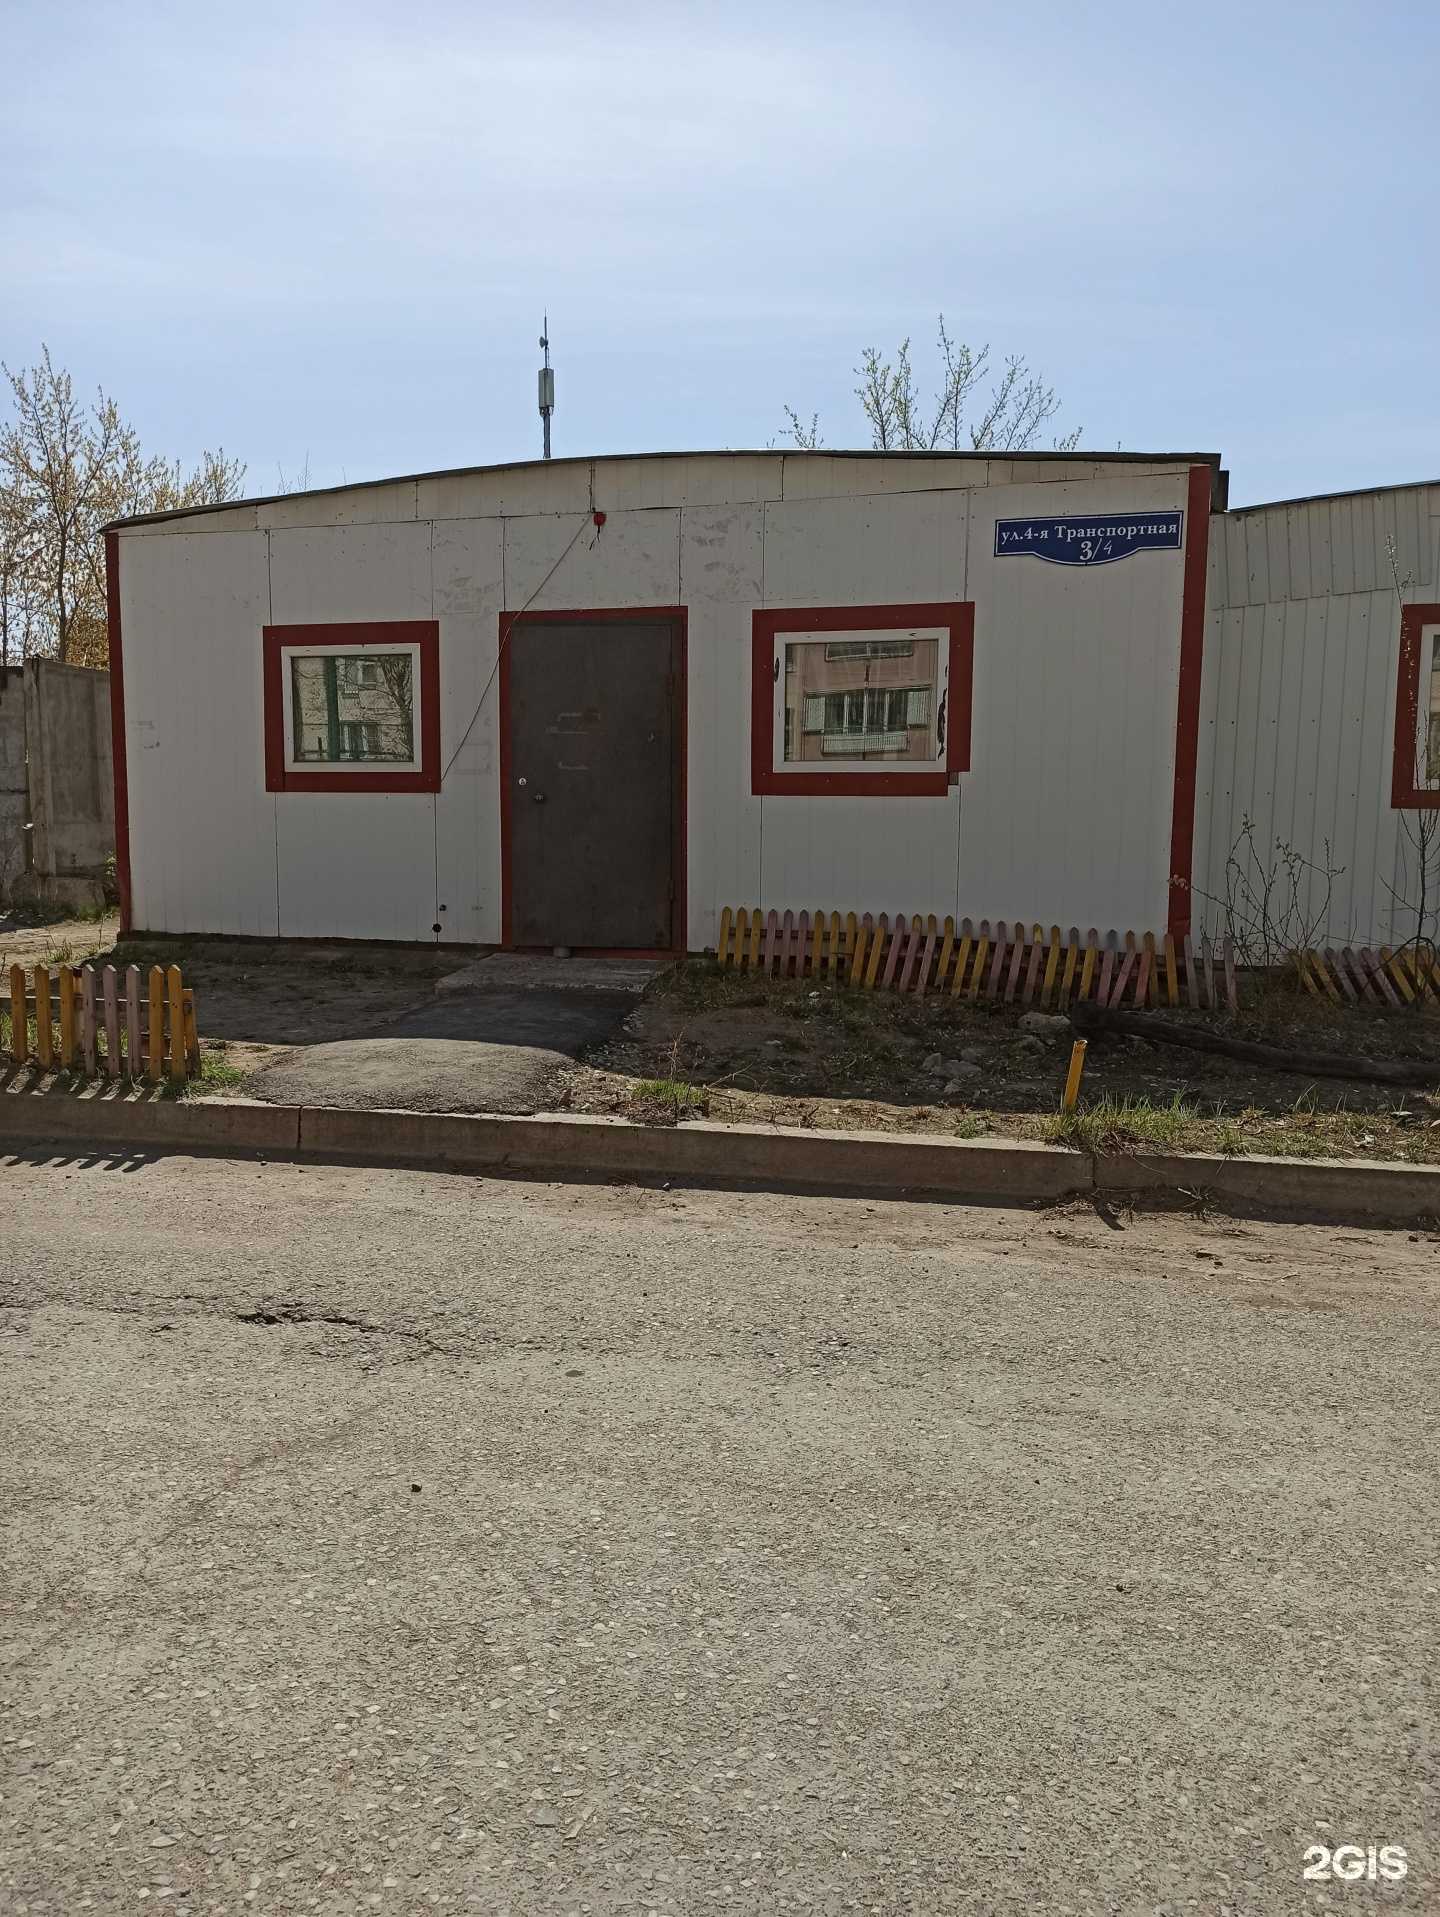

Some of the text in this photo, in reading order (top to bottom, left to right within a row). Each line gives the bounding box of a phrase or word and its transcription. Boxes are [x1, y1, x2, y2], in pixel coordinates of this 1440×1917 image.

[1001, 523, 1177, 544] ул.4-я Транспортная
[1079, 538, 1113, 561] 3/4
